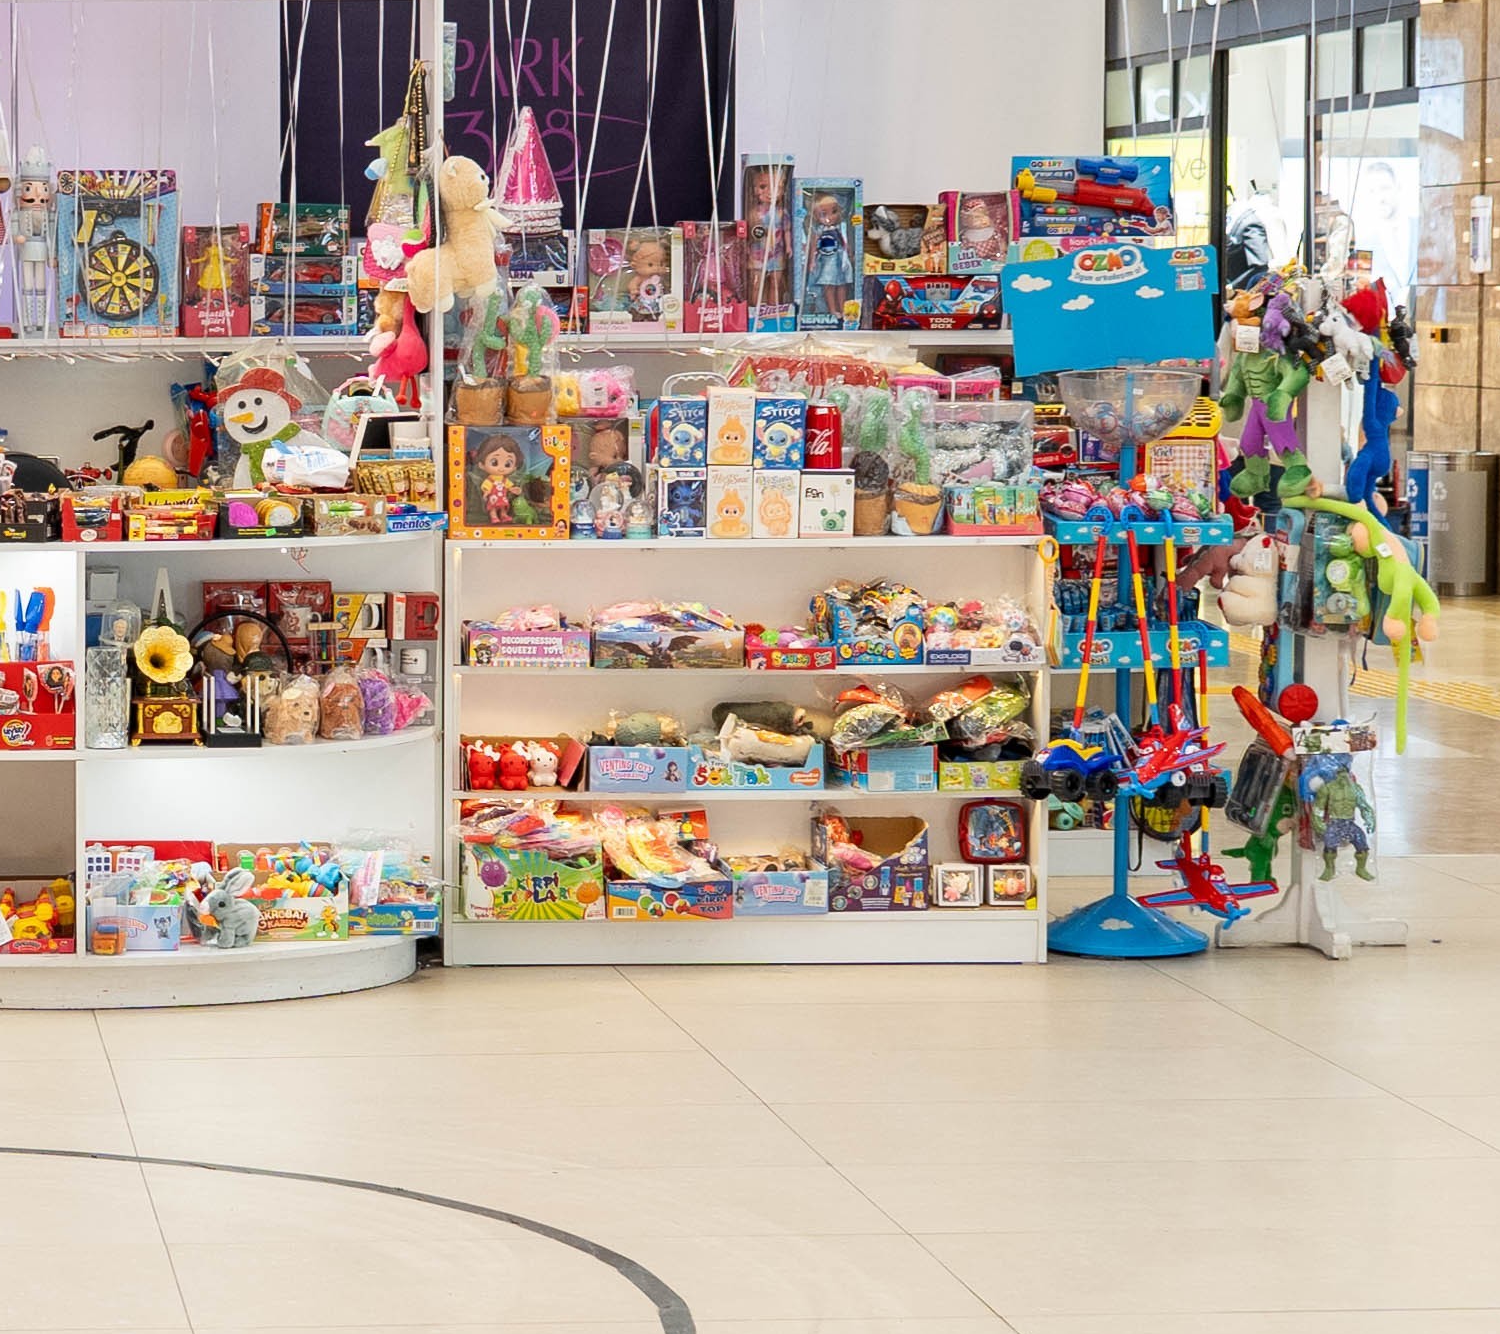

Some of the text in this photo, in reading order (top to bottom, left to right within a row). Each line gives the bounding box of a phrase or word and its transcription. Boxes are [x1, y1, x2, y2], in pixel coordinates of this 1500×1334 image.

[455, 38, 584, 96] PARK
[457, 112, 582, 178] 38
[391, 518, 431, 532] mentos
[599, 760, 632, 774] VENTING
